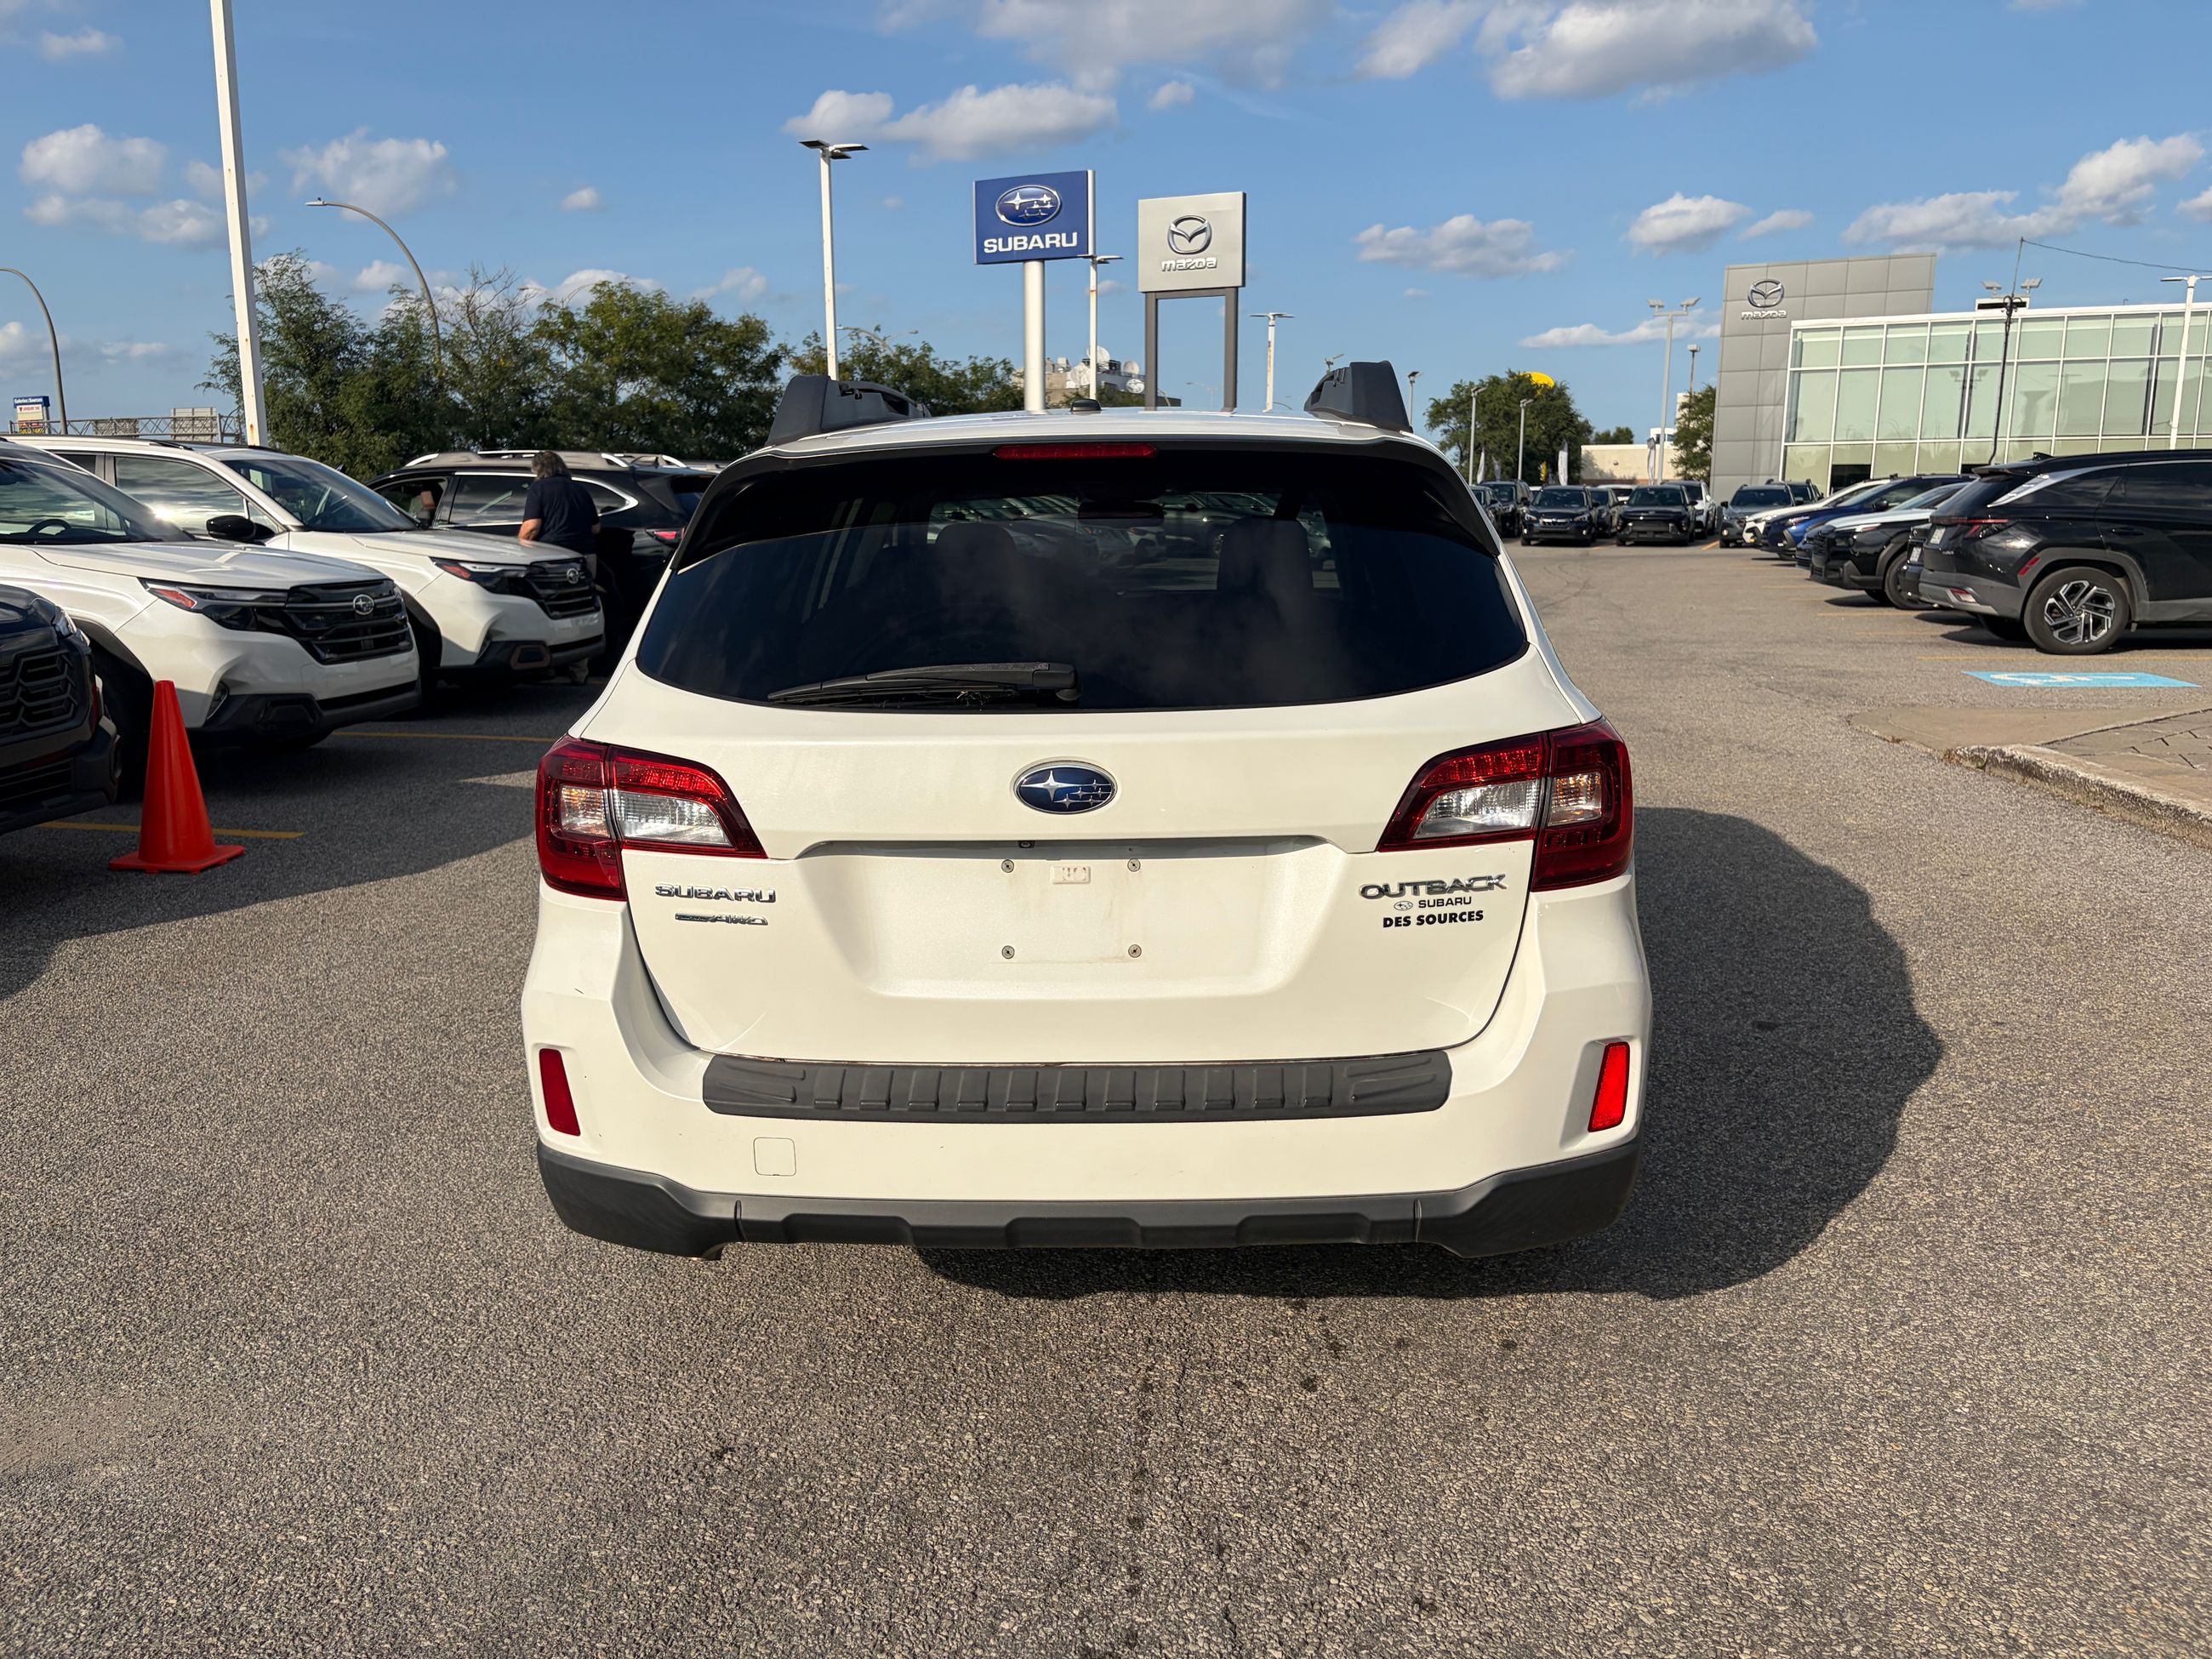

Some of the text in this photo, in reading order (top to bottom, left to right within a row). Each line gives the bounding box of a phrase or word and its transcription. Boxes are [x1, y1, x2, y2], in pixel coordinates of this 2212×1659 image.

[983, 232, 1078, 254] SUBARU
[1160, 256, 1217, 272] mazda
[1742, 310, 1787, 320] mazda
[655, 883, 776, 903] SUBARU
[1359, 874, 1507, 899] OUTBACK
[1418, 896, 1472, 909] SUBARU
[1382, 909, 1485, 928] DES SOURCES
